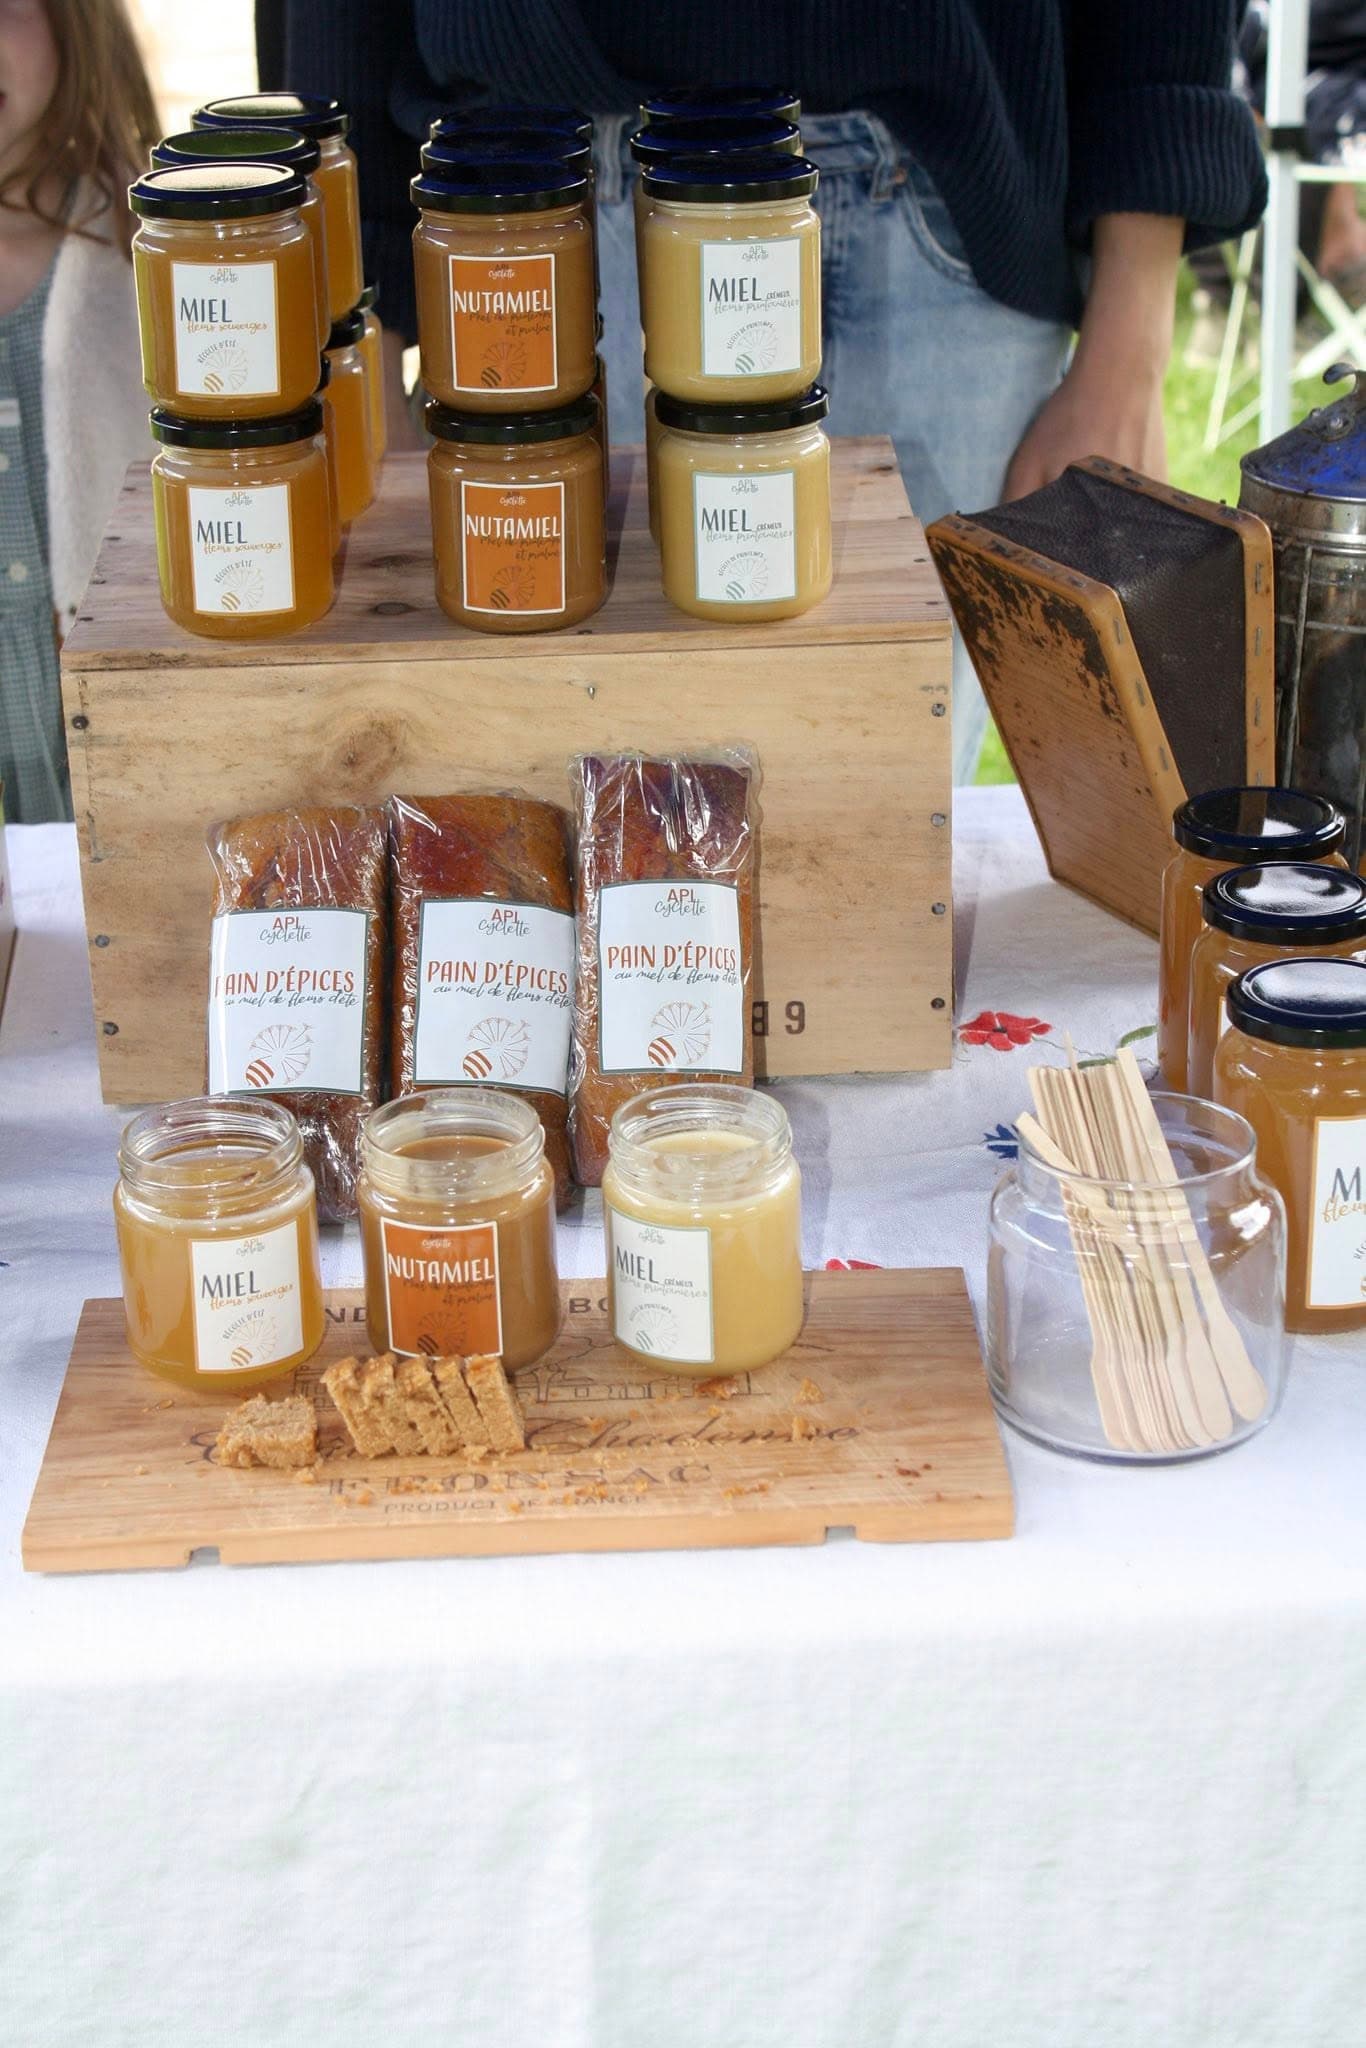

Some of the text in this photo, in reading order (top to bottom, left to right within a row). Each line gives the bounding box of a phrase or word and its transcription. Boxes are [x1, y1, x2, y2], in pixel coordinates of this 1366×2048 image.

[454, 289, 552, 314] NUTAMIEL
[709, 277, 762, 303] MIEL
[180, 297, 233, 323] MIEL
[197, 520, 248, 544] MIEL
[466, 514, 561, 540] NUTAMIEL
[701, 507, 752, 532] MIEL
[667, 888, 695, 903] API
[273, 916, 299, 930] API
[491, 908, 519, 924] API
[608, 941, 736, 971] PAIN D'ÉPICES
[266, 966, 355, 993] D'ÉPICES
[427, 960, 568, 994] PAIN D'ÉPICES
[614, 971, 633, 980] au
[636, 967, 665, 984] miel
[669, 965, 685, 981] de
[687, 968, 720, 985] fleurs
[238, 993, 265, 1007] miel
[269, 989, 286, 1005] de
[288, 991, 323, 1007] fleurs
[433, 985, 451, 994] au
[455, 982, 485, 998] miel
[487, 982, 506, 996] de
[506, 985, 542, 1004] fleurs
[388, 1253, 495, 1284] NUTAMIEL
[616, 1245, 659, 1284] MIEL
[201, 1270, 260, 1299] MIEL
[384, 1499, 497, 1515] PRODUCT
